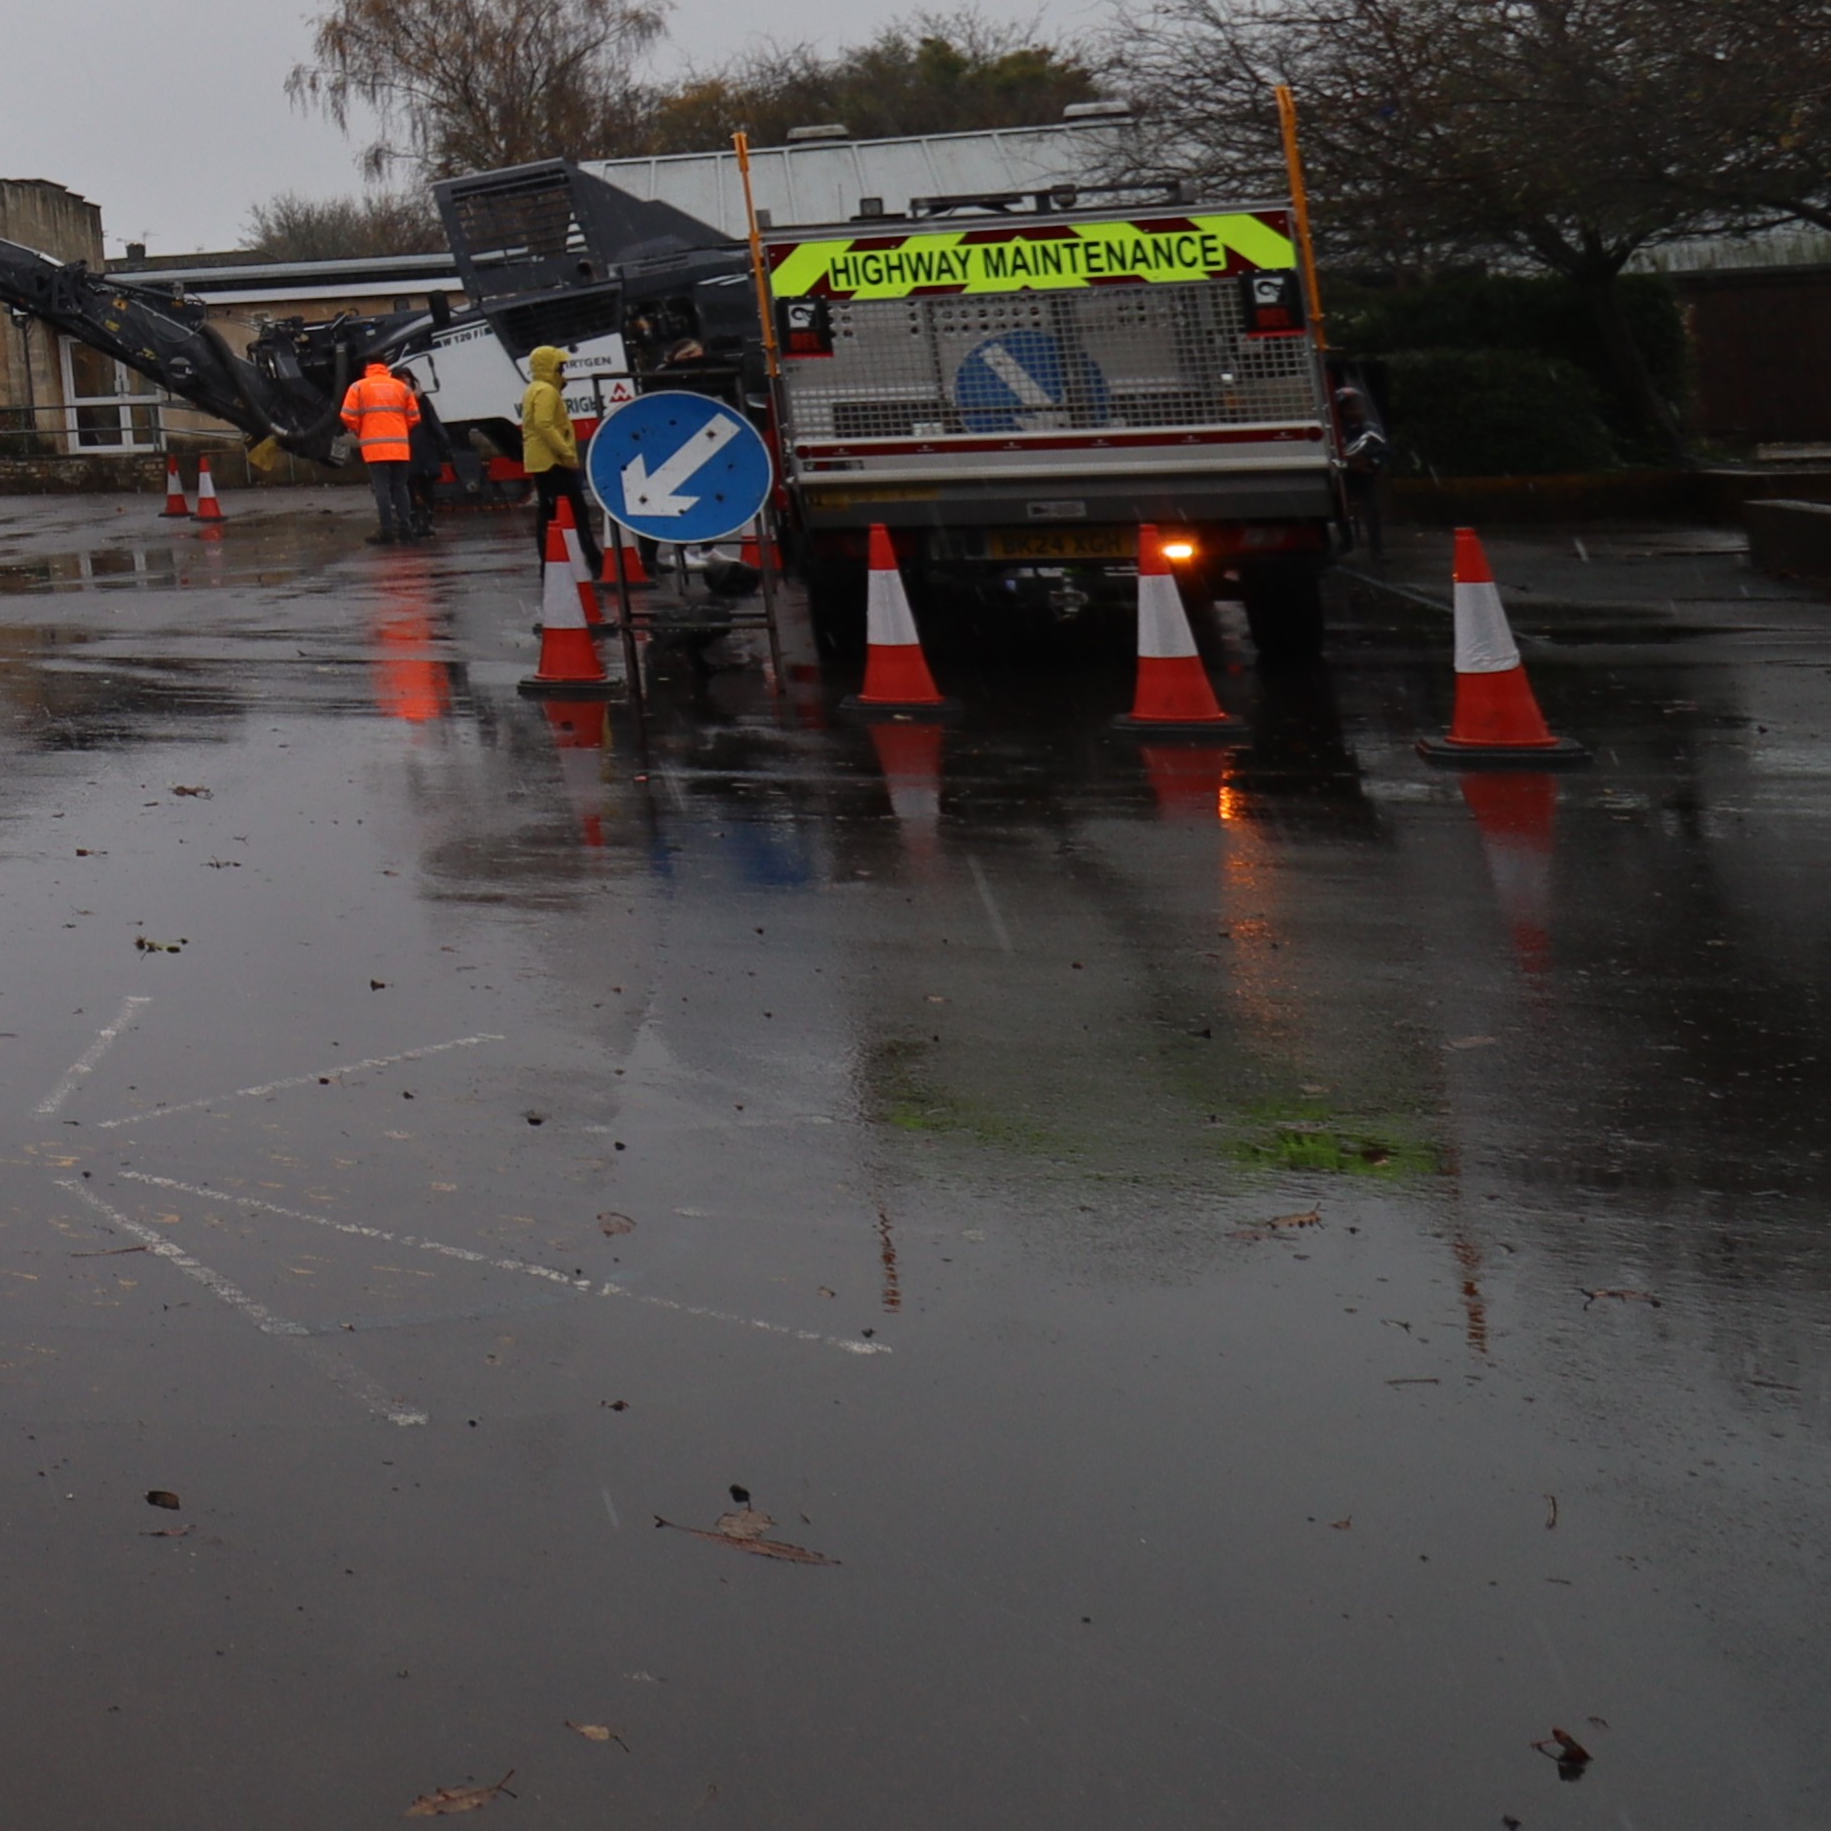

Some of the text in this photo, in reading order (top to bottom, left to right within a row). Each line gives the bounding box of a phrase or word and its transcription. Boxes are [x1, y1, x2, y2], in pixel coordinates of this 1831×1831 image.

[830, 234, 1222, 288] HIGHWAY MAINTENANCE
[454, 331, 472, 344] 120
[564, 355, 612, 370] IRTGEN
